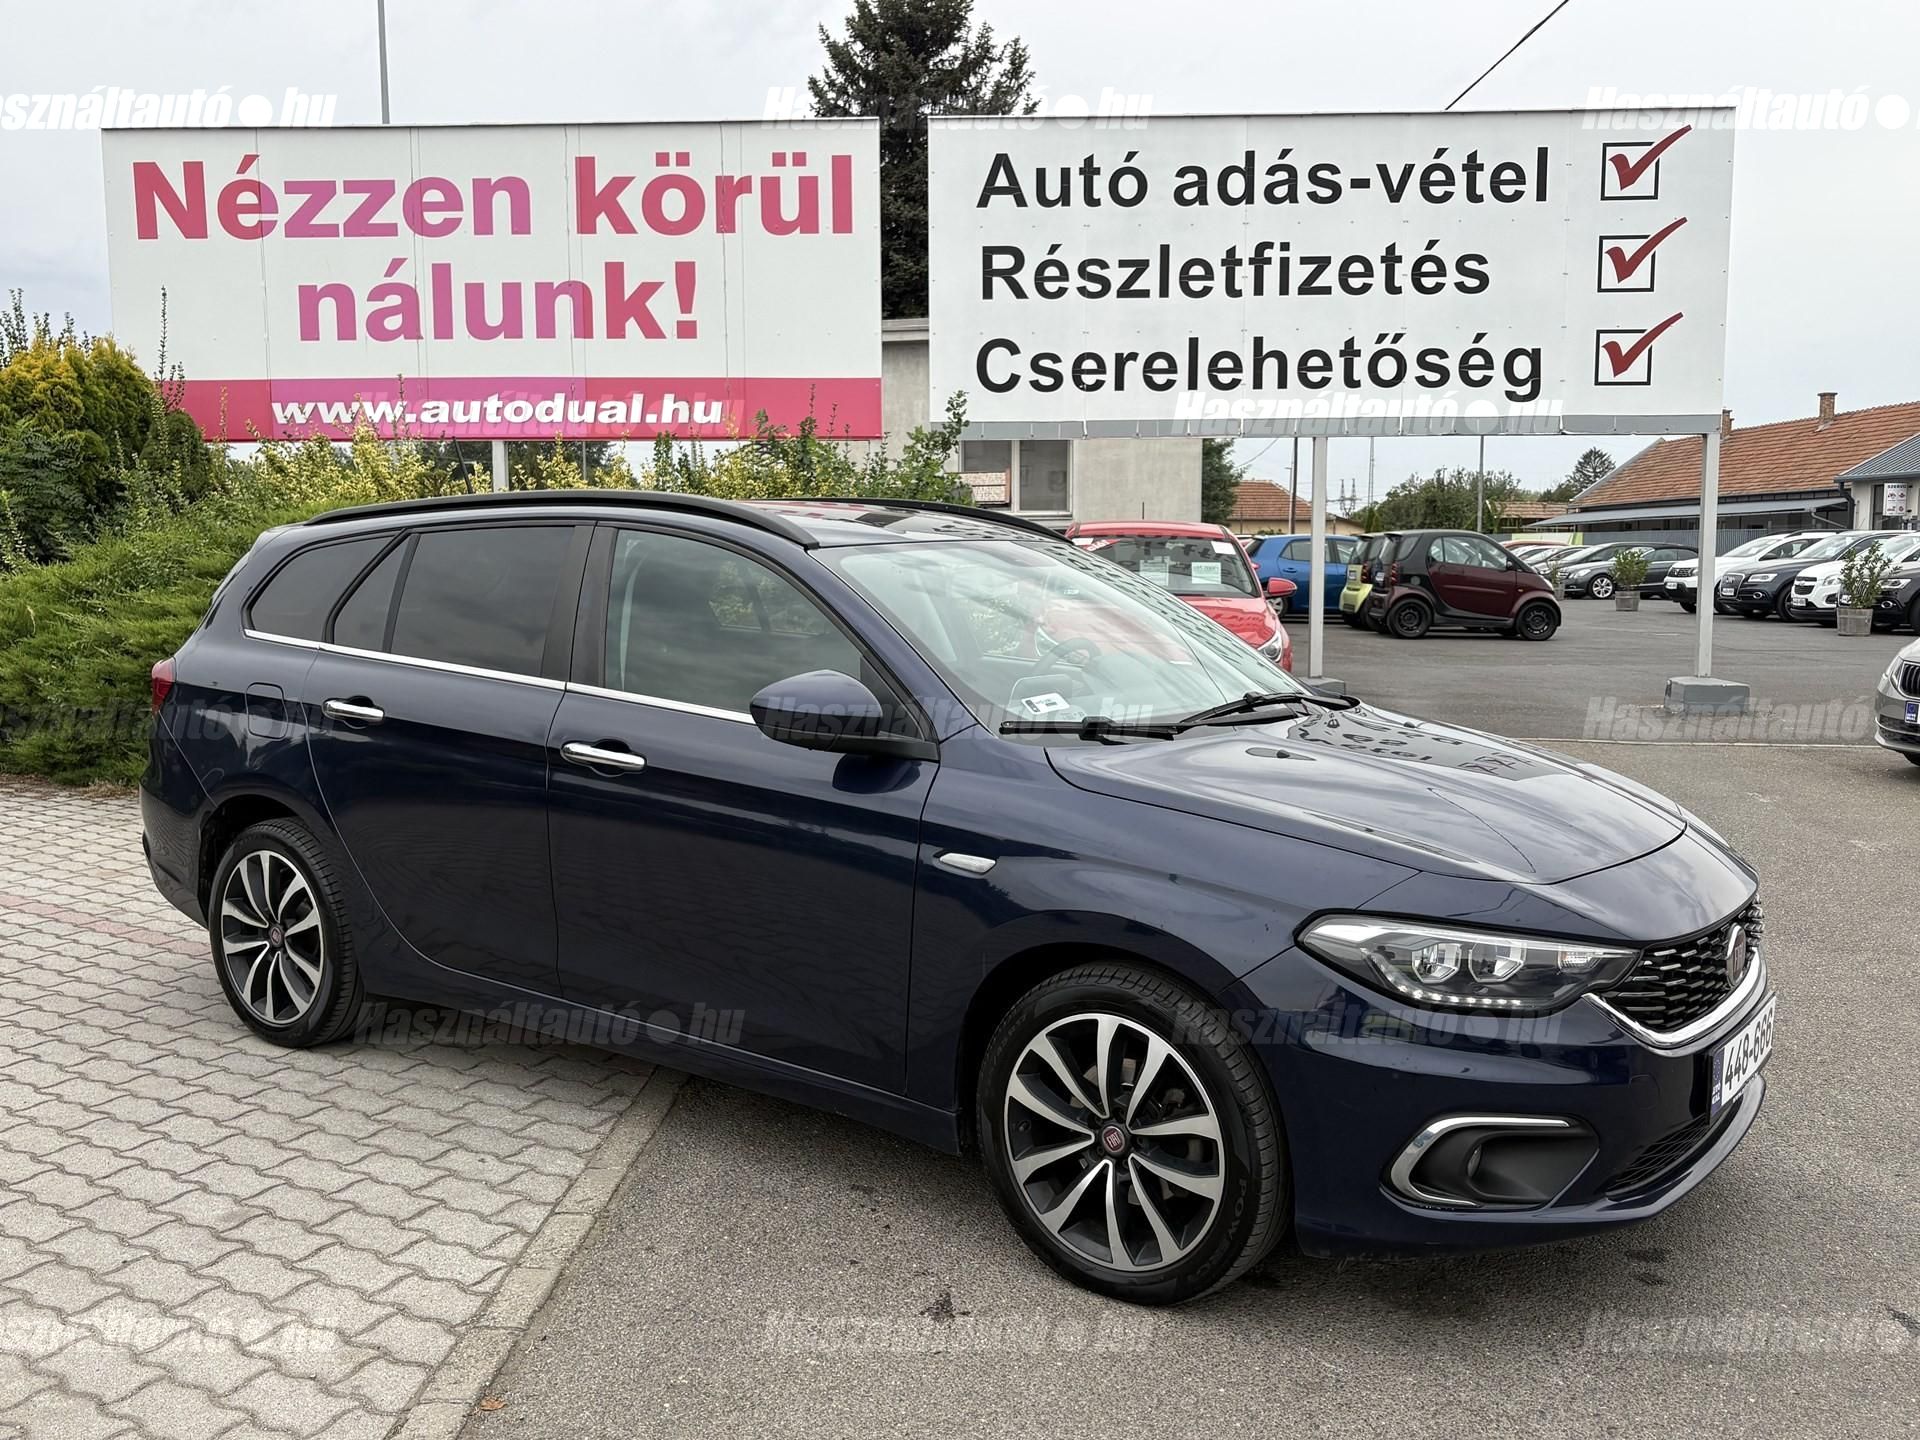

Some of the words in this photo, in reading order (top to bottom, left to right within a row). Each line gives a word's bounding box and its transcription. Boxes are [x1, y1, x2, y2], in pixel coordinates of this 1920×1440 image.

[133, 154, 531, 241] Nézzen
[575, 151, 854, 237] körül
[976, 151, 1149, 208] Autó
[1173, 146, 1550, 206] adás-vétel
[299, 258, 698, 342] nálunk!
[981, 239, 1491, 300] Részletfizetés
[976, 331, 1542, 402] Cserelehetőség
[272, 393, 723, 424] www.autodual.hu
